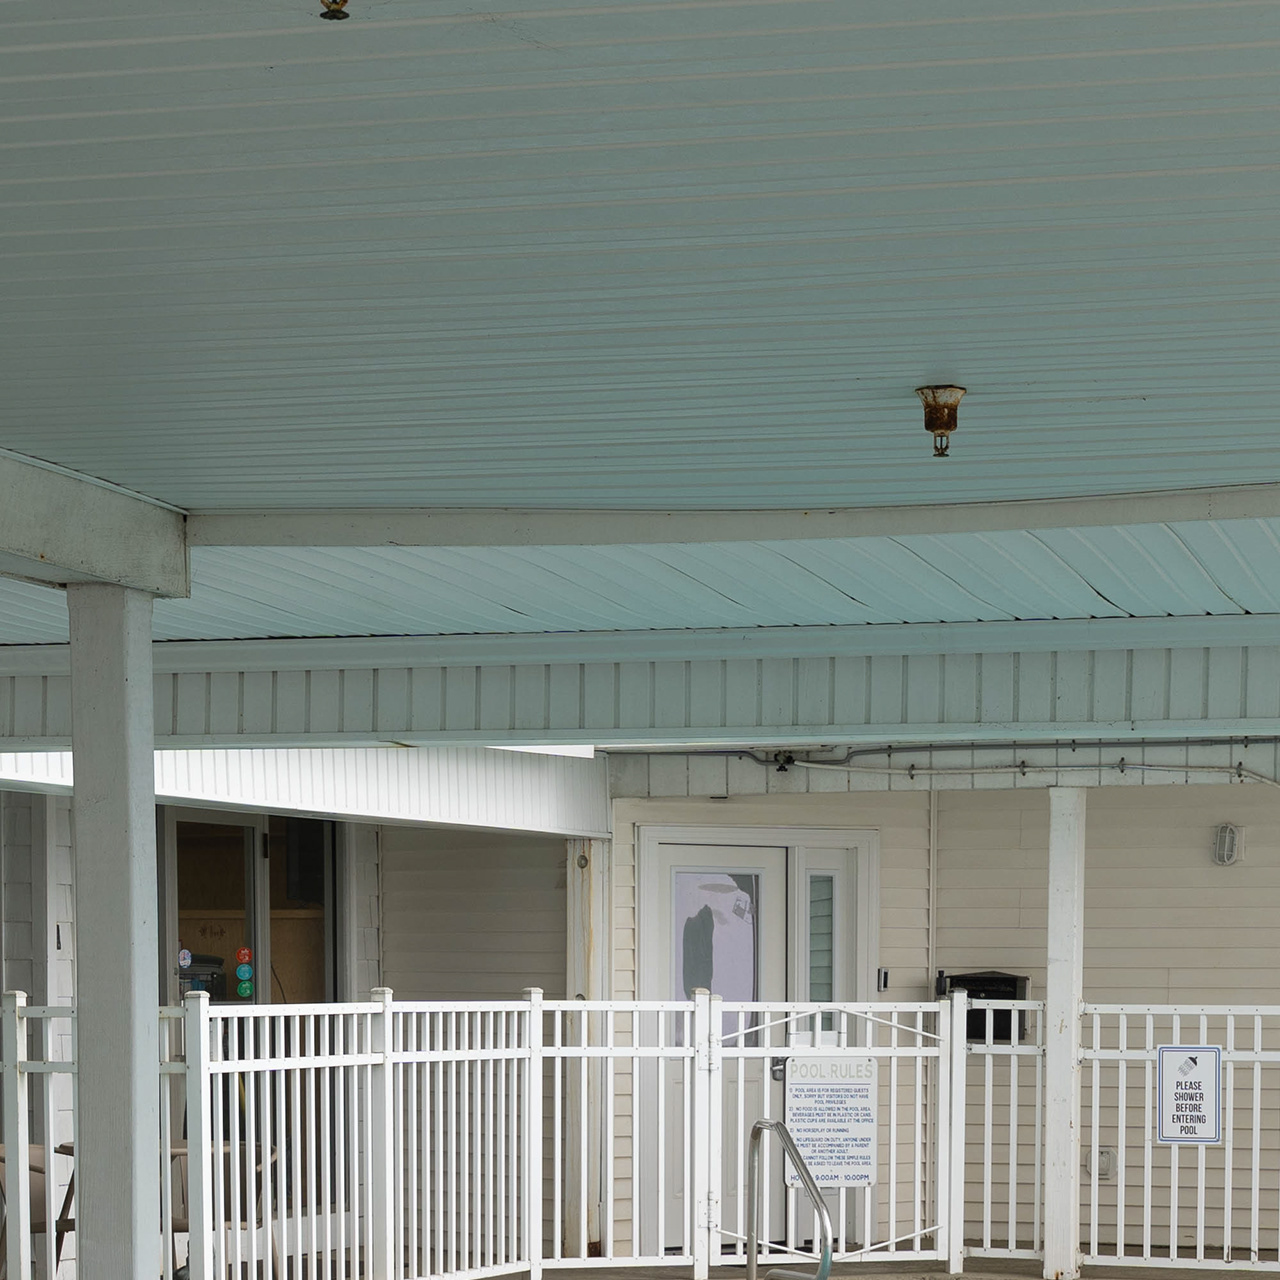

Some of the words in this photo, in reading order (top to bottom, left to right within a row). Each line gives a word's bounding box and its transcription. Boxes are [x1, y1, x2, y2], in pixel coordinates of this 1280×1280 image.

[791, 1064, 825, 1078] POOL
[831, 1064, 872, 1078] RULES
[1176, 1081, 1202, 1090] PLEASE
[1174, 1092, 1204, 1101] SHOWER
[1176, 1103, 1202, 1112] BEFORE
[1172, 1114, 1207, 1124] ENTERING
[1180, 1126, 1198, 1134] POOL
